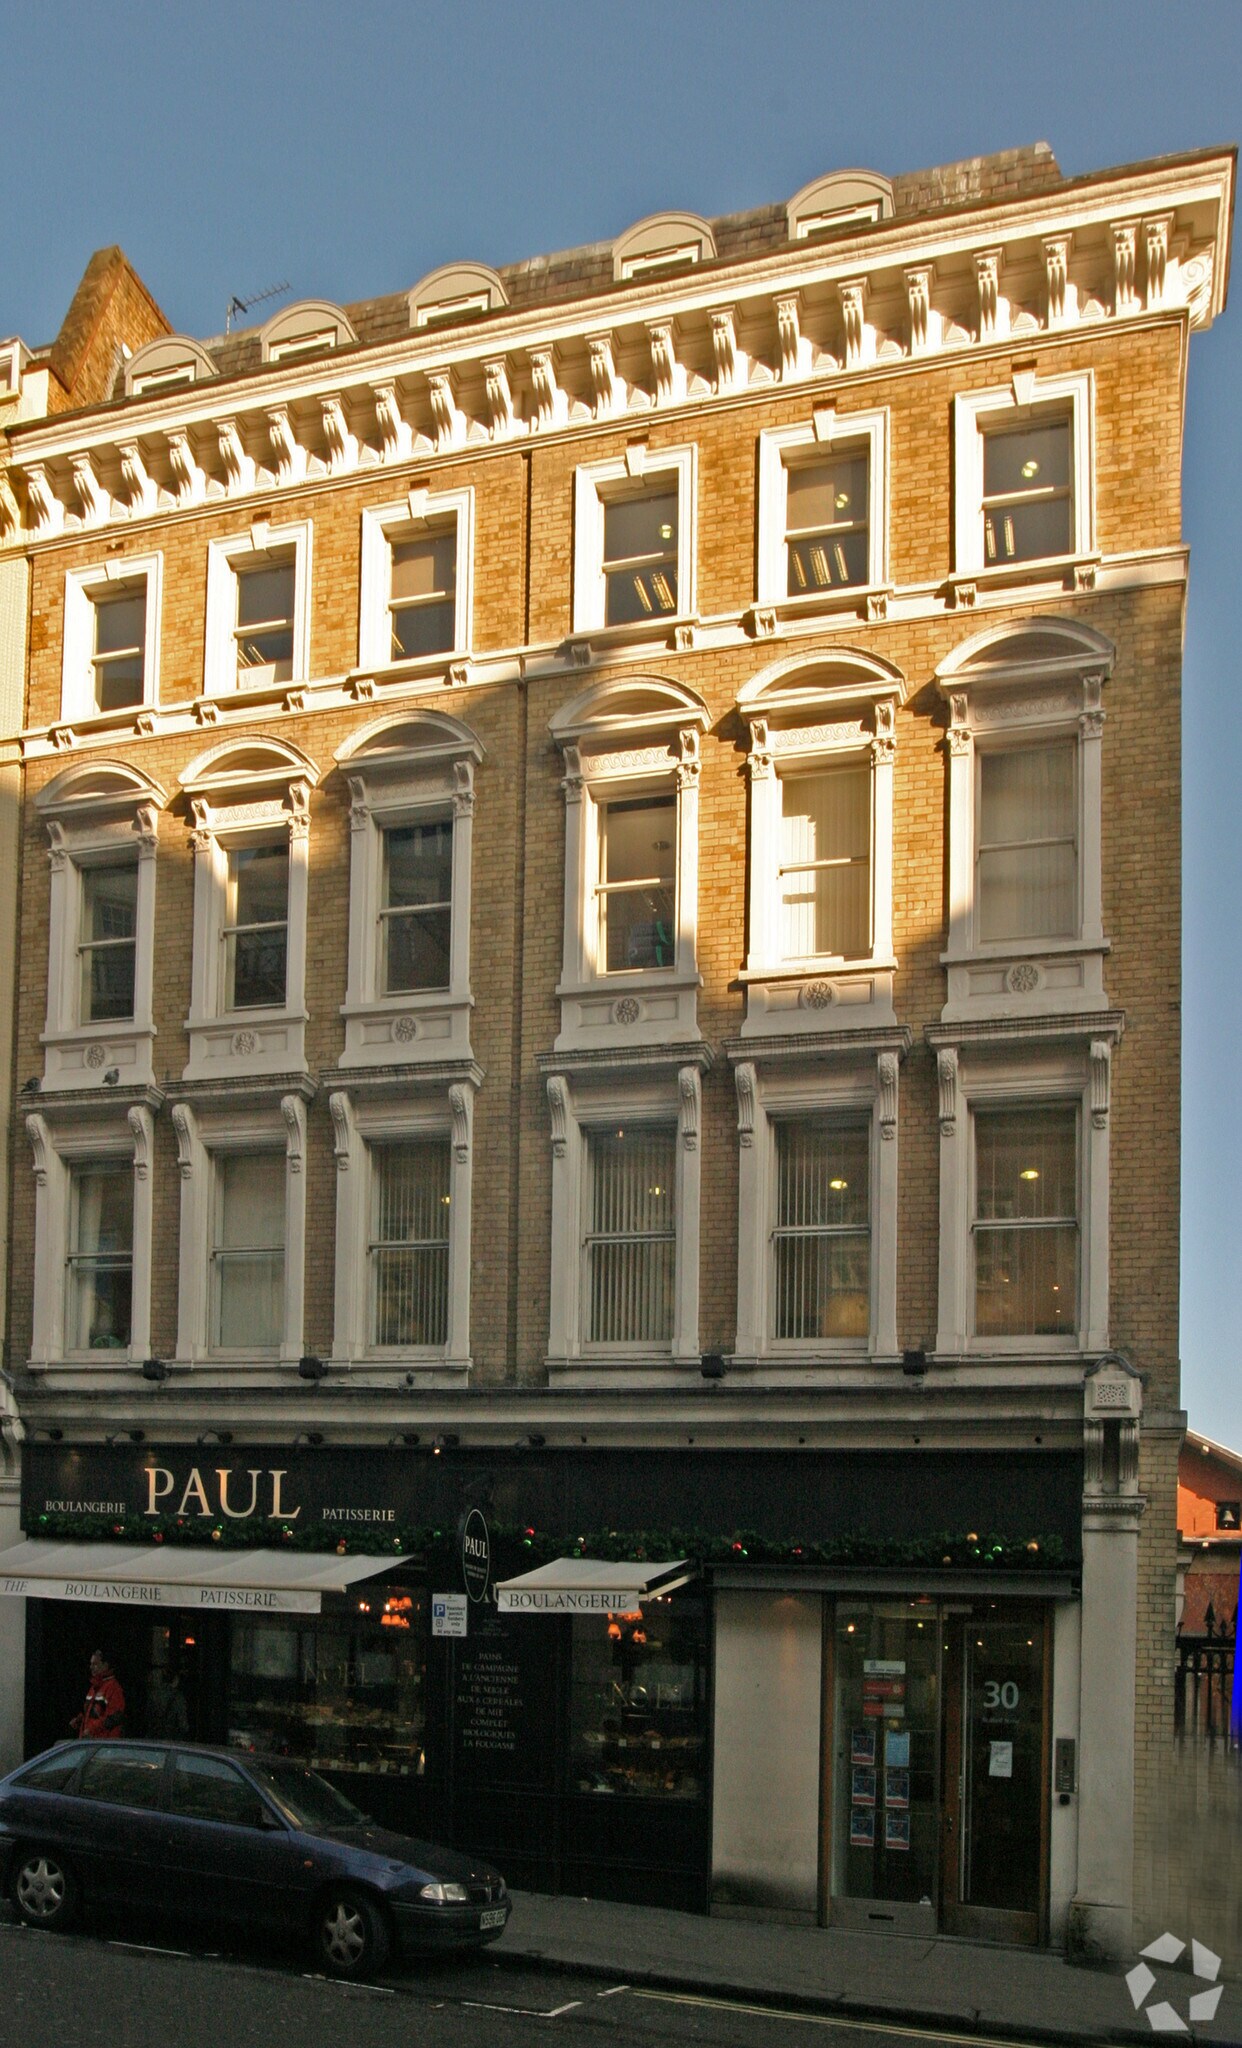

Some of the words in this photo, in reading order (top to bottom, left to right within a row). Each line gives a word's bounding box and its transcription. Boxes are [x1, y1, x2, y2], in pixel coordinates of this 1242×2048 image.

[144, 1467, 301, 1519] PAUL
[45, 1500, 126, 1514] BOULANGERIE
[322, 1508, 396, 1522] PATISSERIE
[465, 1535, 488, 1559] PAUL
[4, 1580, 29, 1592] THE
[65, 1583, 161, 1601] BOULANGERIE
[200, 1590, 277, 1607] PATISSERIE
[509, 1593, 628, 1609] BOULANGERIE
[473, 1663, 519, 1673] CAMPAGNE
[983, 1680, 1019, 1709] 30
[470, 1718, 508, 1727] COMPLET
[463, 1728, 516, 1739] BIOLOGIQUES
[475, 1740, 515, 1750] FOUGASSE
